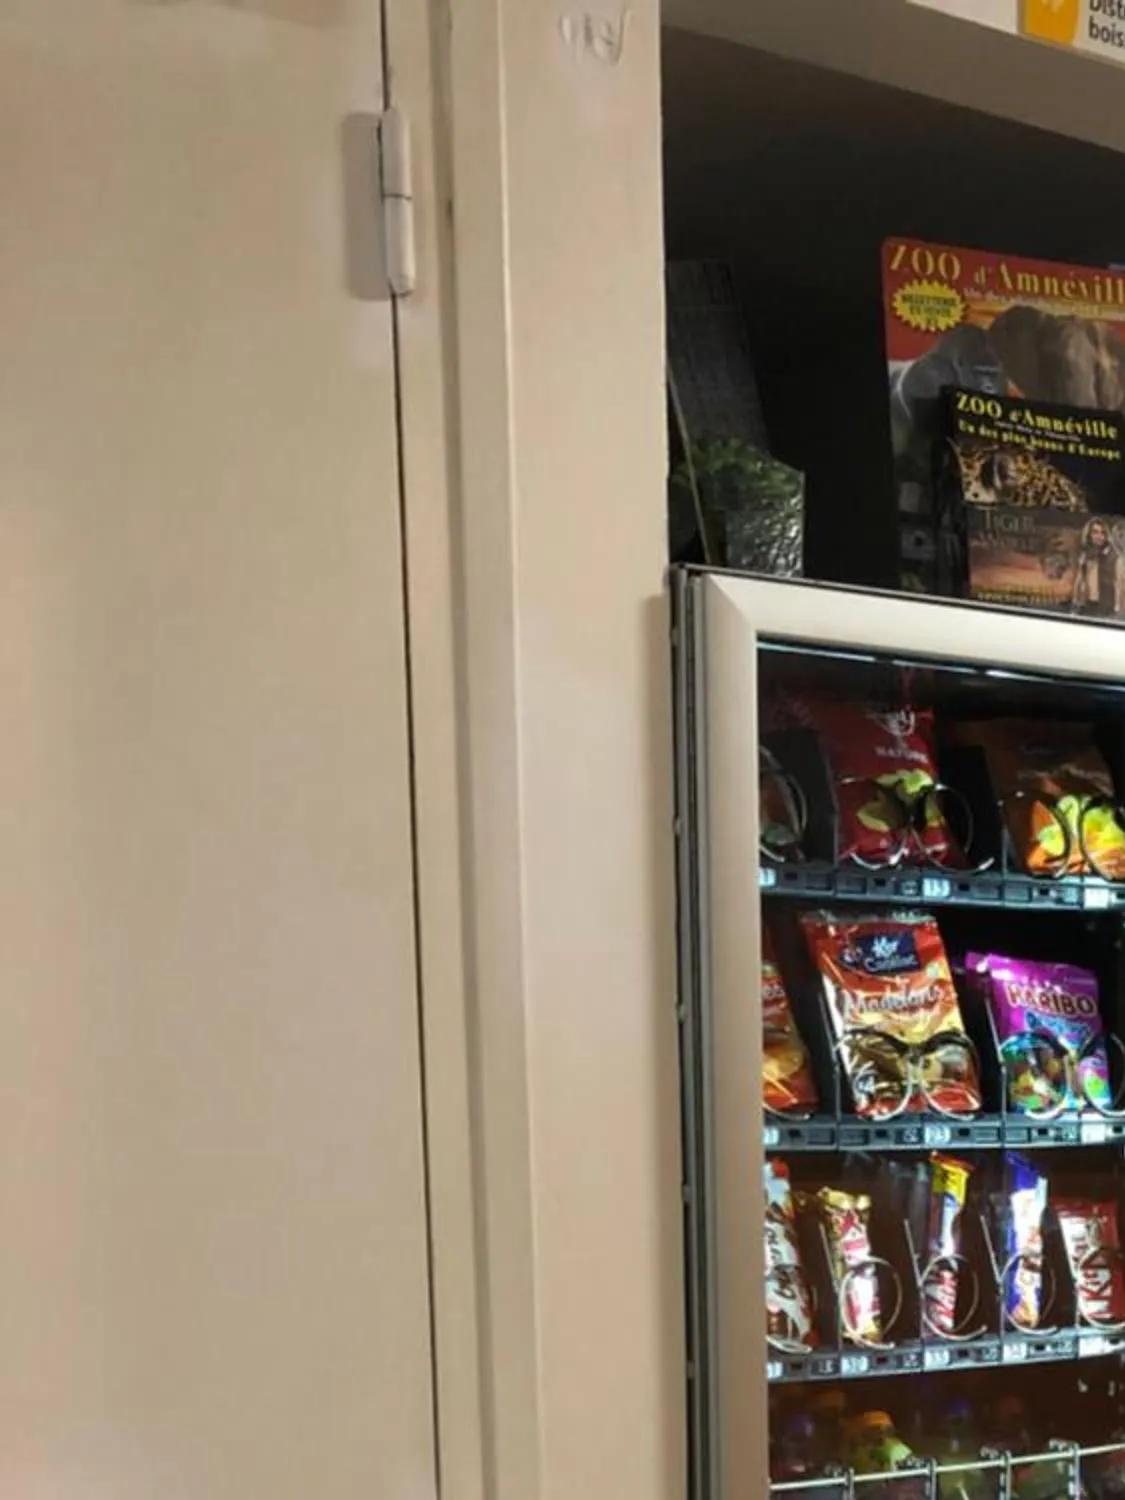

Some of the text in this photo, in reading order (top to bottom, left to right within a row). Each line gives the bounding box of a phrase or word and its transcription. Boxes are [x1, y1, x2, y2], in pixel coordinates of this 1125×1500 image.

[890, 244, 961, 280] ZOO
[955, 391, 1002, 419] ZOO
[1005, 981, 1097, 1018] HARIBO
